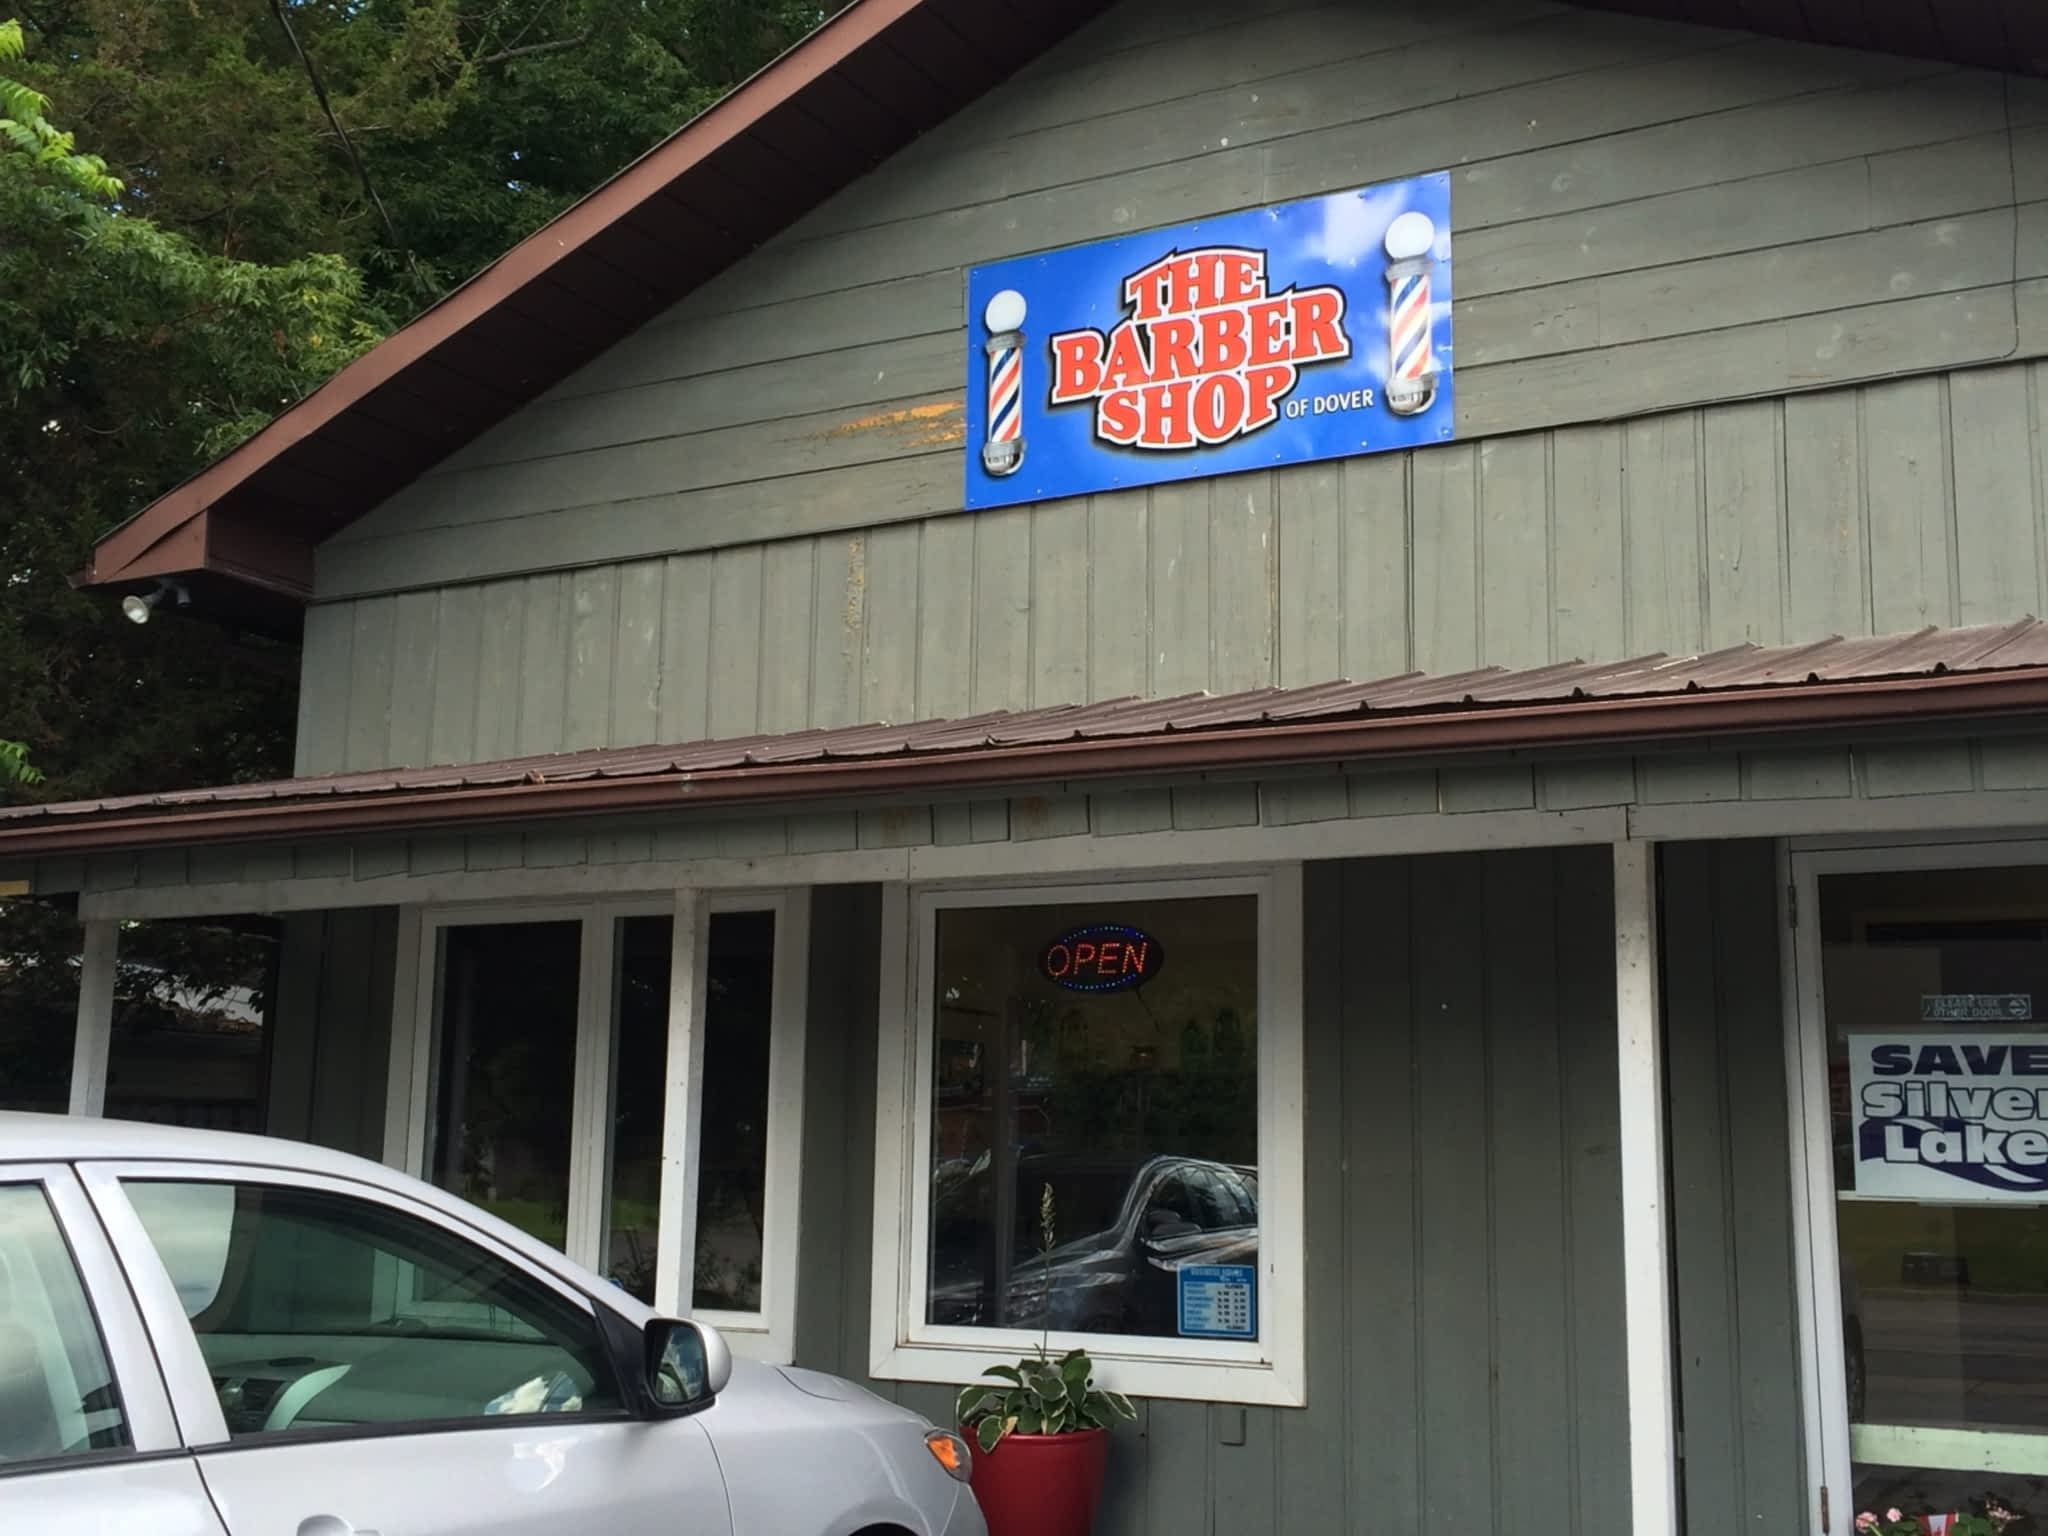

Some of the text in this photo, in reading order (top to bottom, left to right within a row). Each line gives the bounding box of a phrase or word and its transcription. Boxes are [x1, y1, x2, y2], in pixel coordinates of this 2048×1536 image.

[1128, 252, 1263, 321] THE
[1054, 290, 1346, 400] BARBER
[1100, 365, 1293, 445] SHOP
[1286, 388, 1374, 419] OF DOVER
[1047, 941, 1149, 976] OPEN
[1871, 1044, 2048, 1076] SAVE
[1884, 1123, 2048, 1166] Lake
